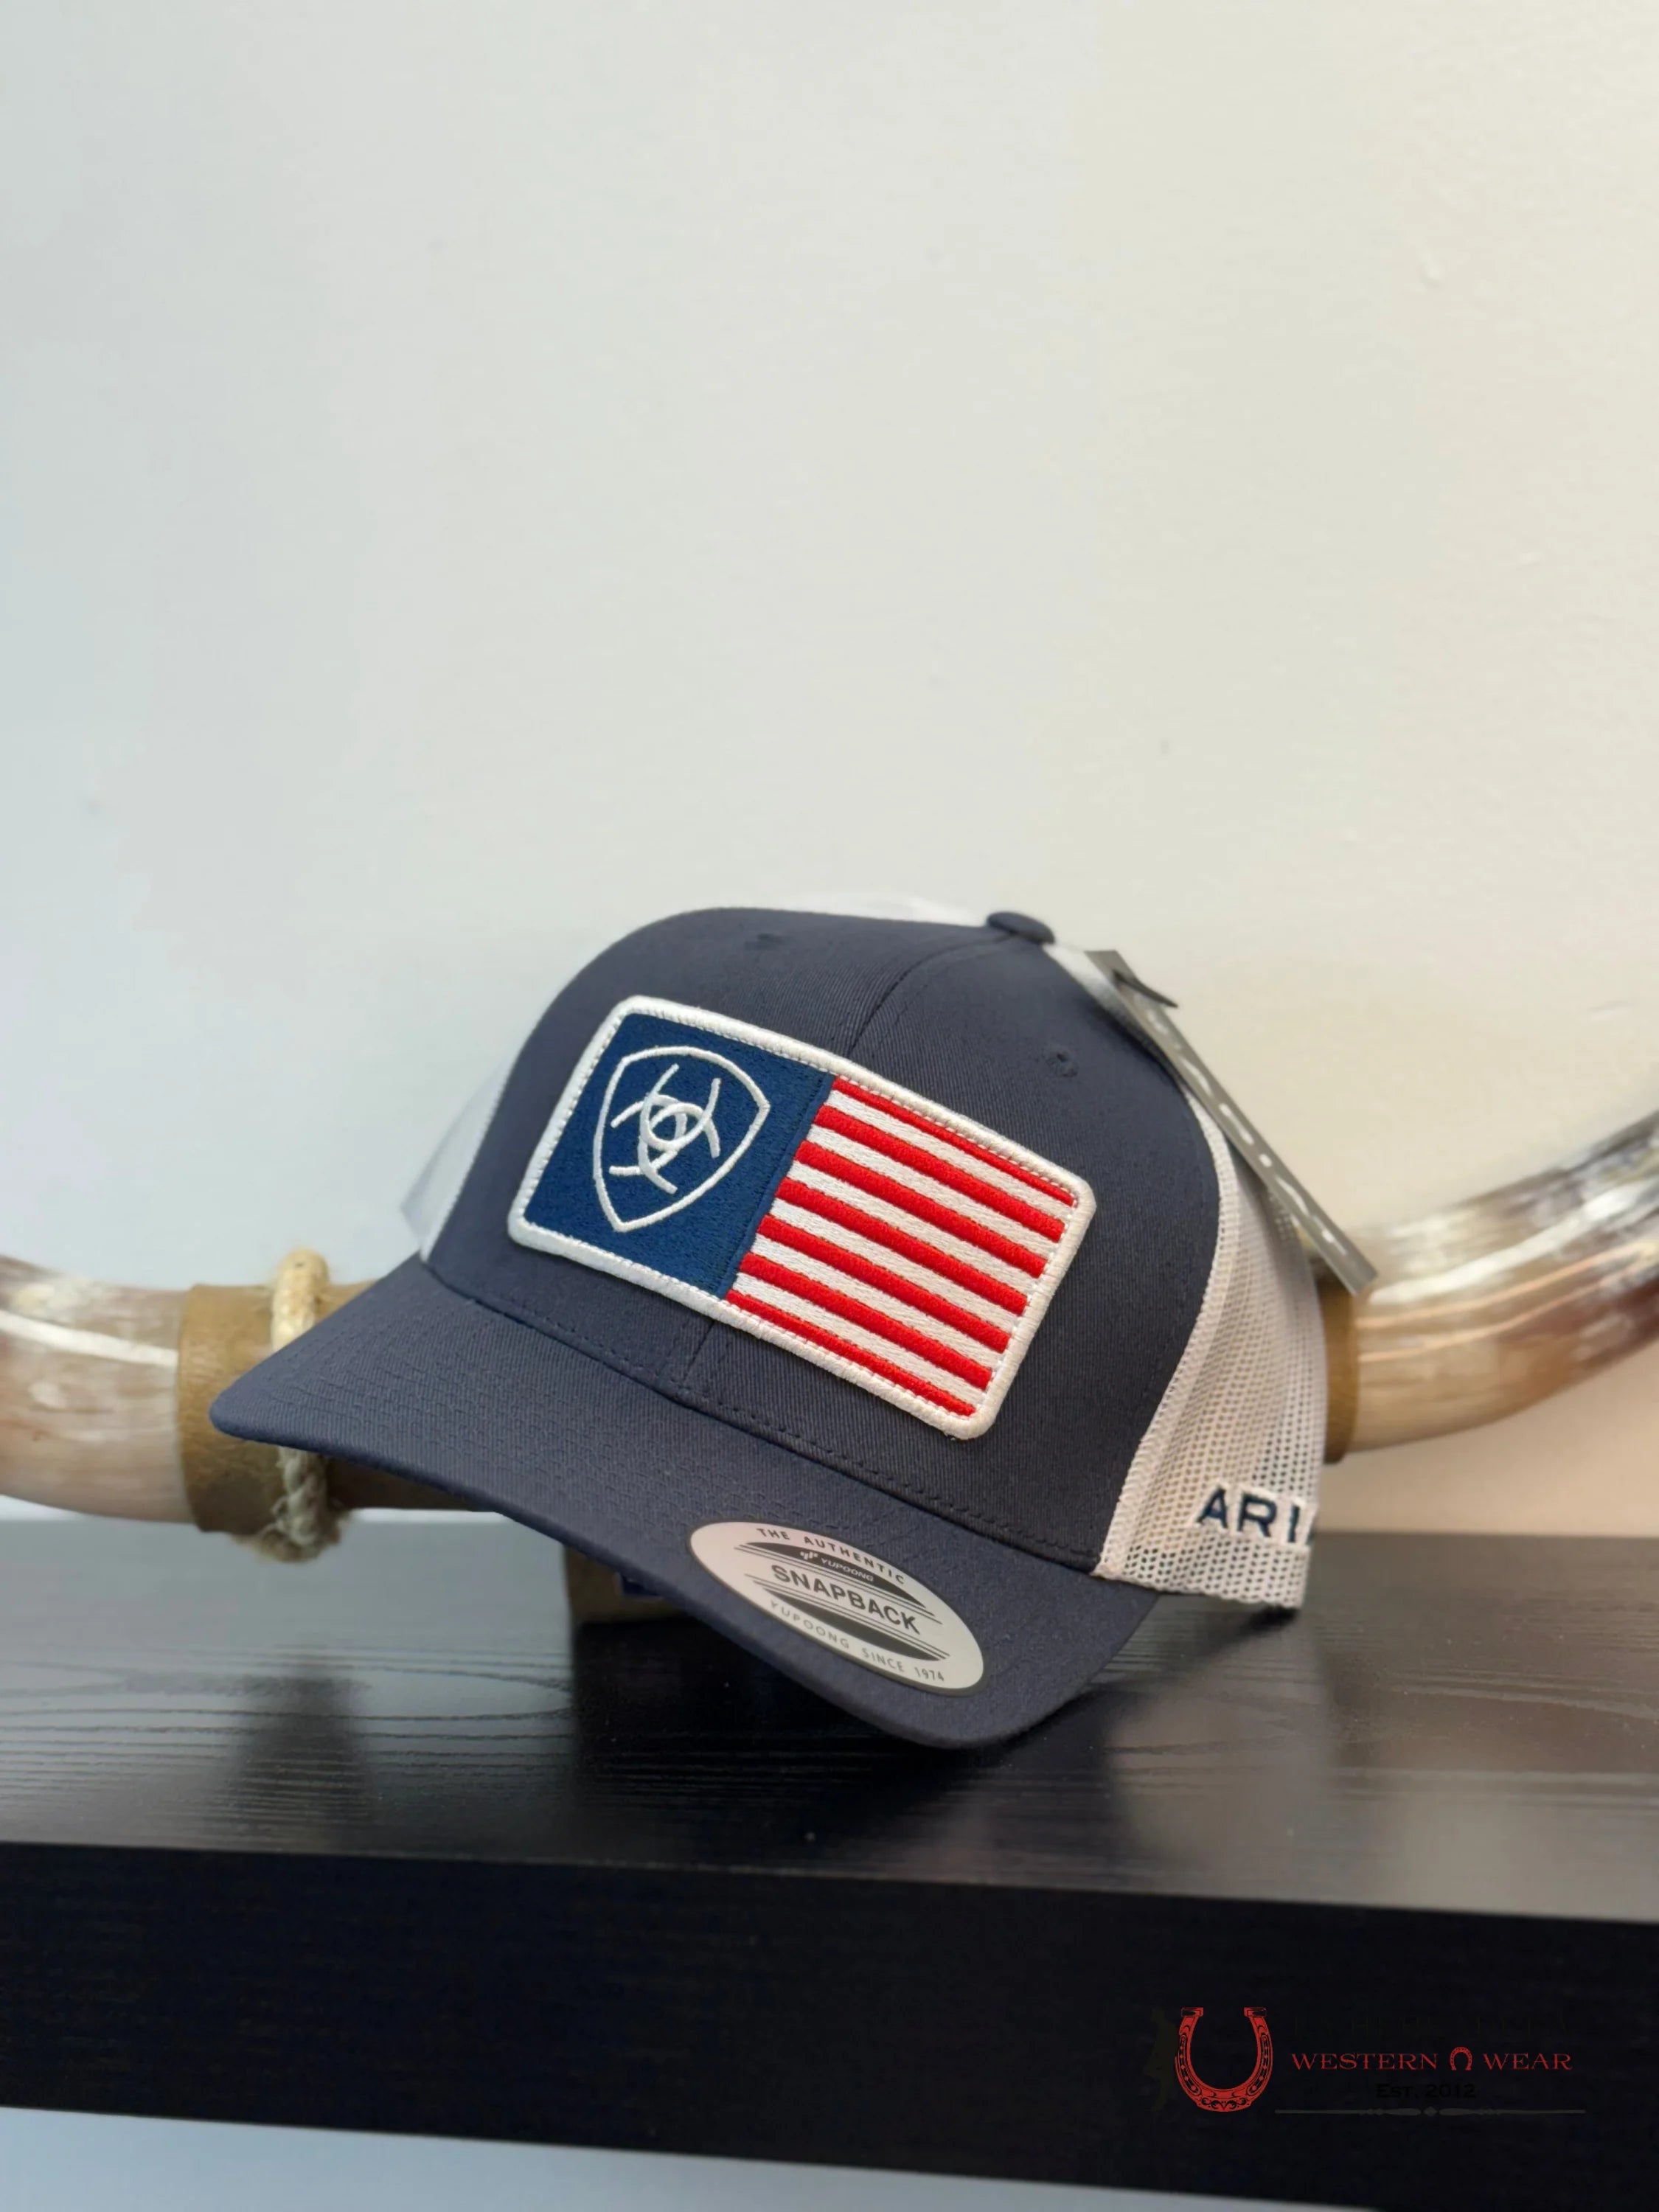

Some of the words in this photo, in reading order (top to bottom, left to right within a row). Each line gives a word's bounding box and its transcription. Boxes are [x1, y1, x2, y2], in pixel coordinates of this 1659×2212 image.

[1196, 1486, 1314, 1545] ARI
[757, 1528, 790, 1541] THE
[804, 1536, 905, 1585] AUTHENTIC
[821, 1558, 874, 1582] YUPOONG
[771, 1565, 920, 1635] SNAPBACK
[769, 1600, 850, 1650] YUPOONG
[861, 1647, 905, 1672] SINCE
[914, 1667, 945, 1682] 1974
